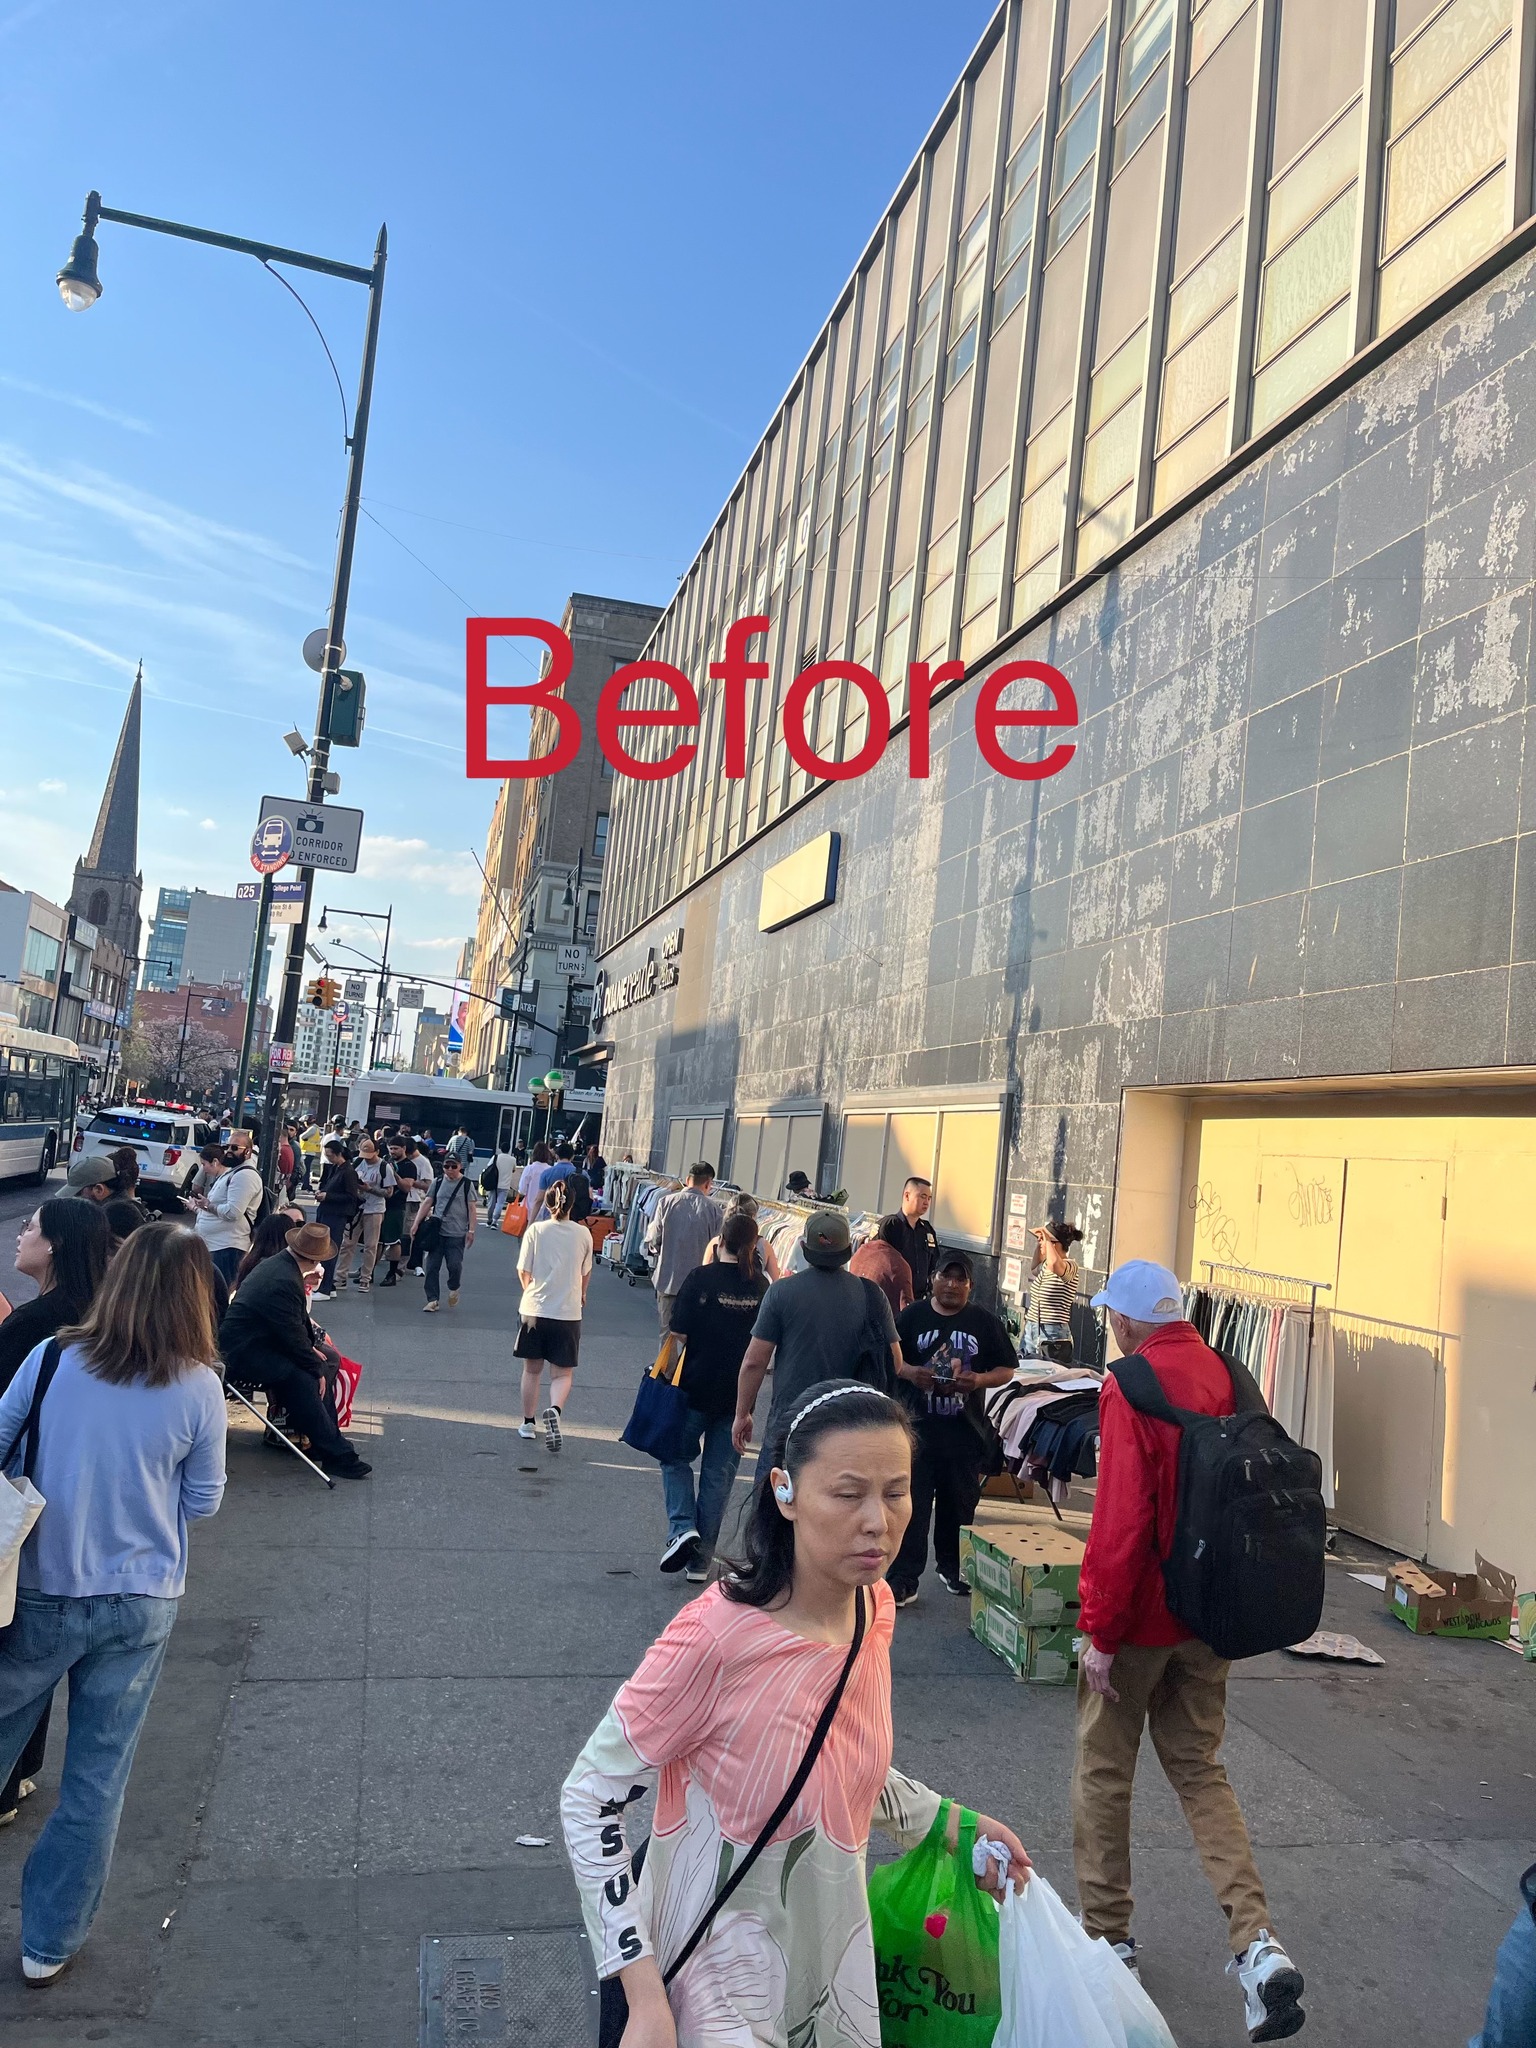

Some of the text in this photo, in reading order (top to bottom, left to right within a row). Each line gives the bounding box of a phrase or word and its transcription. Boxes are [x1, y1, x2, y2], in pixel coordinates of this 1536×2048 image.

[296, 837, 343, 851] CORRIDOR
[252, 855, 287, 871] NO STANDING
[299, 852, 347, 866] ENFORCED
[237, 886, 255, 898] Q25
[565, 948, 580, 959] NO
[558, 961, 585, 971] TURNS
[350, 983, 360, 991] NO
[345, 990, 364, 999] TURNS
[519, 1002, 537, 1013] AT&T
[271, 1047, 282, 1060] FOR
[1442, 1615, 1461, 1627] WEST
[918, 1966, 977, 2015] You
